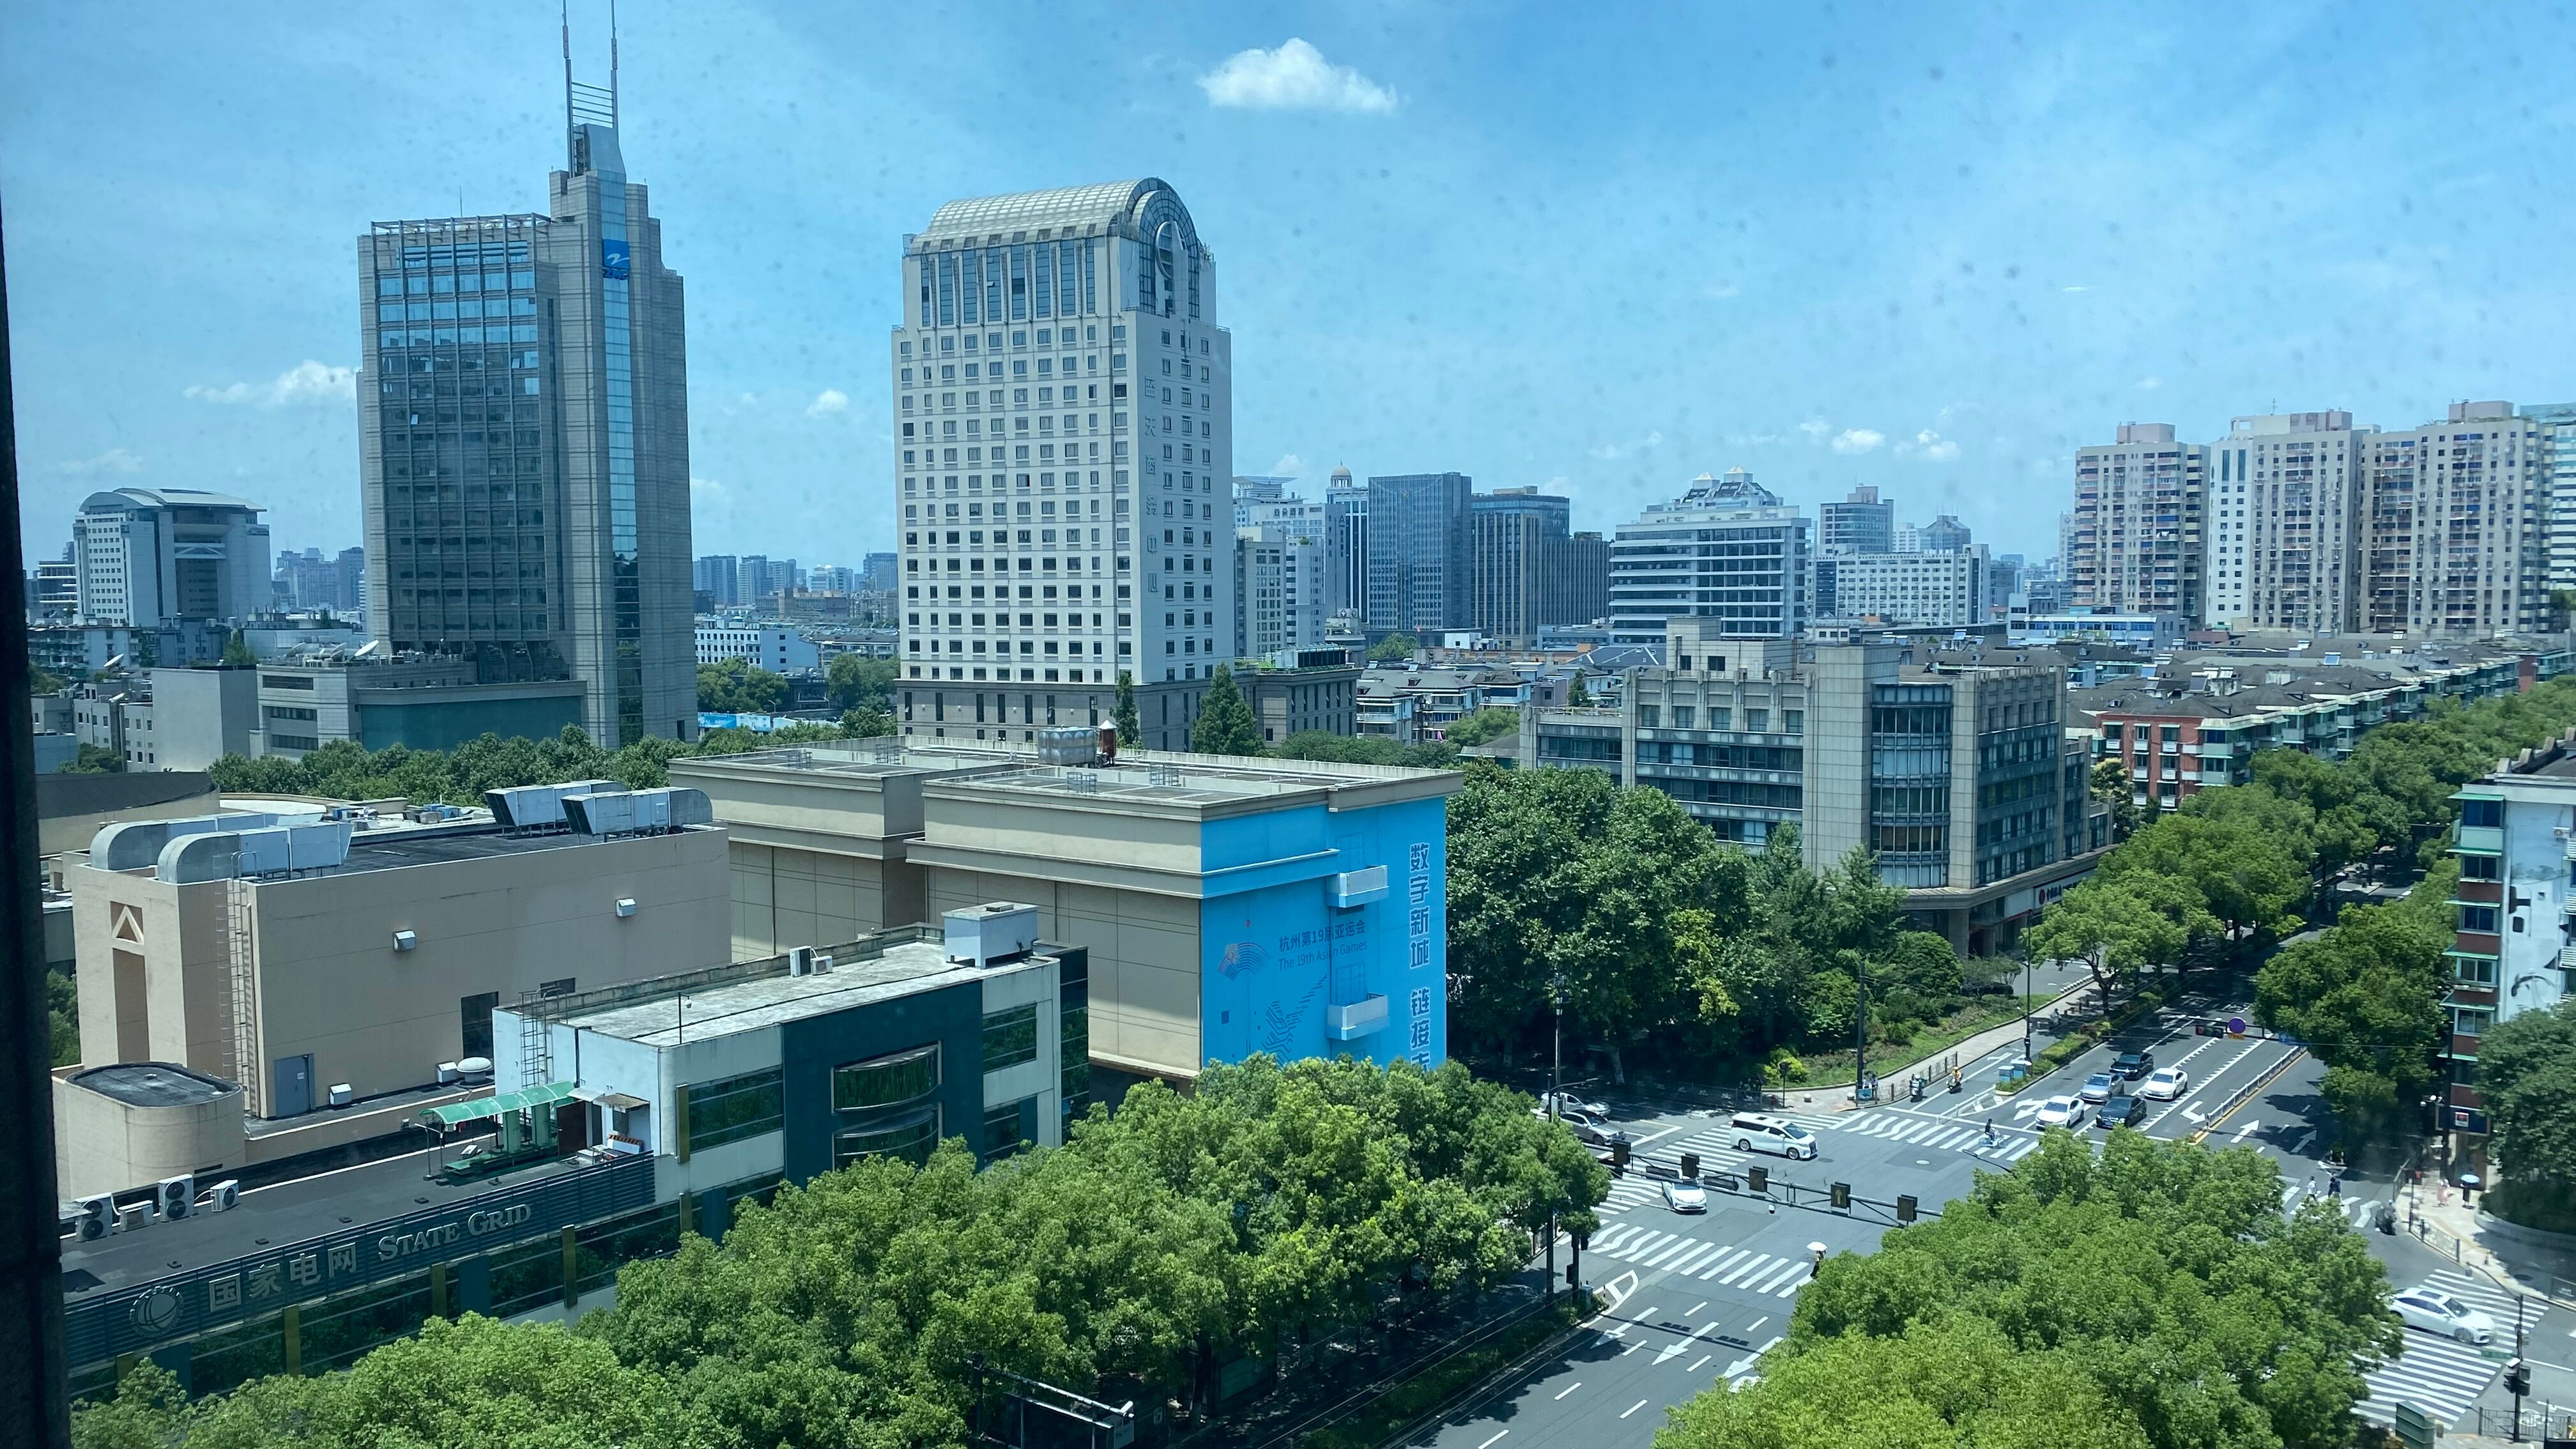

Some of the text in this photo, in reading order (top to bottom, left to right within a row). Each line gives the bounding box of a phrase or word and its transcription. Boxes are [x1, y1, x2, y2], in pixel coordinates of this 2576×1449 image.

[1410, 842, 1430, 969] 数字新城
[1278, 957, 1295, 971] The
[1297, 952, 1315, 966] 19th
[1340, 940, 1368, 956] Games
[1279, 919, 1365, 953] 杭州第19届亚运会
[378, 1203, 532, 1262] STATE GRID
[208, 1241, 358, 1314] 国家电网
